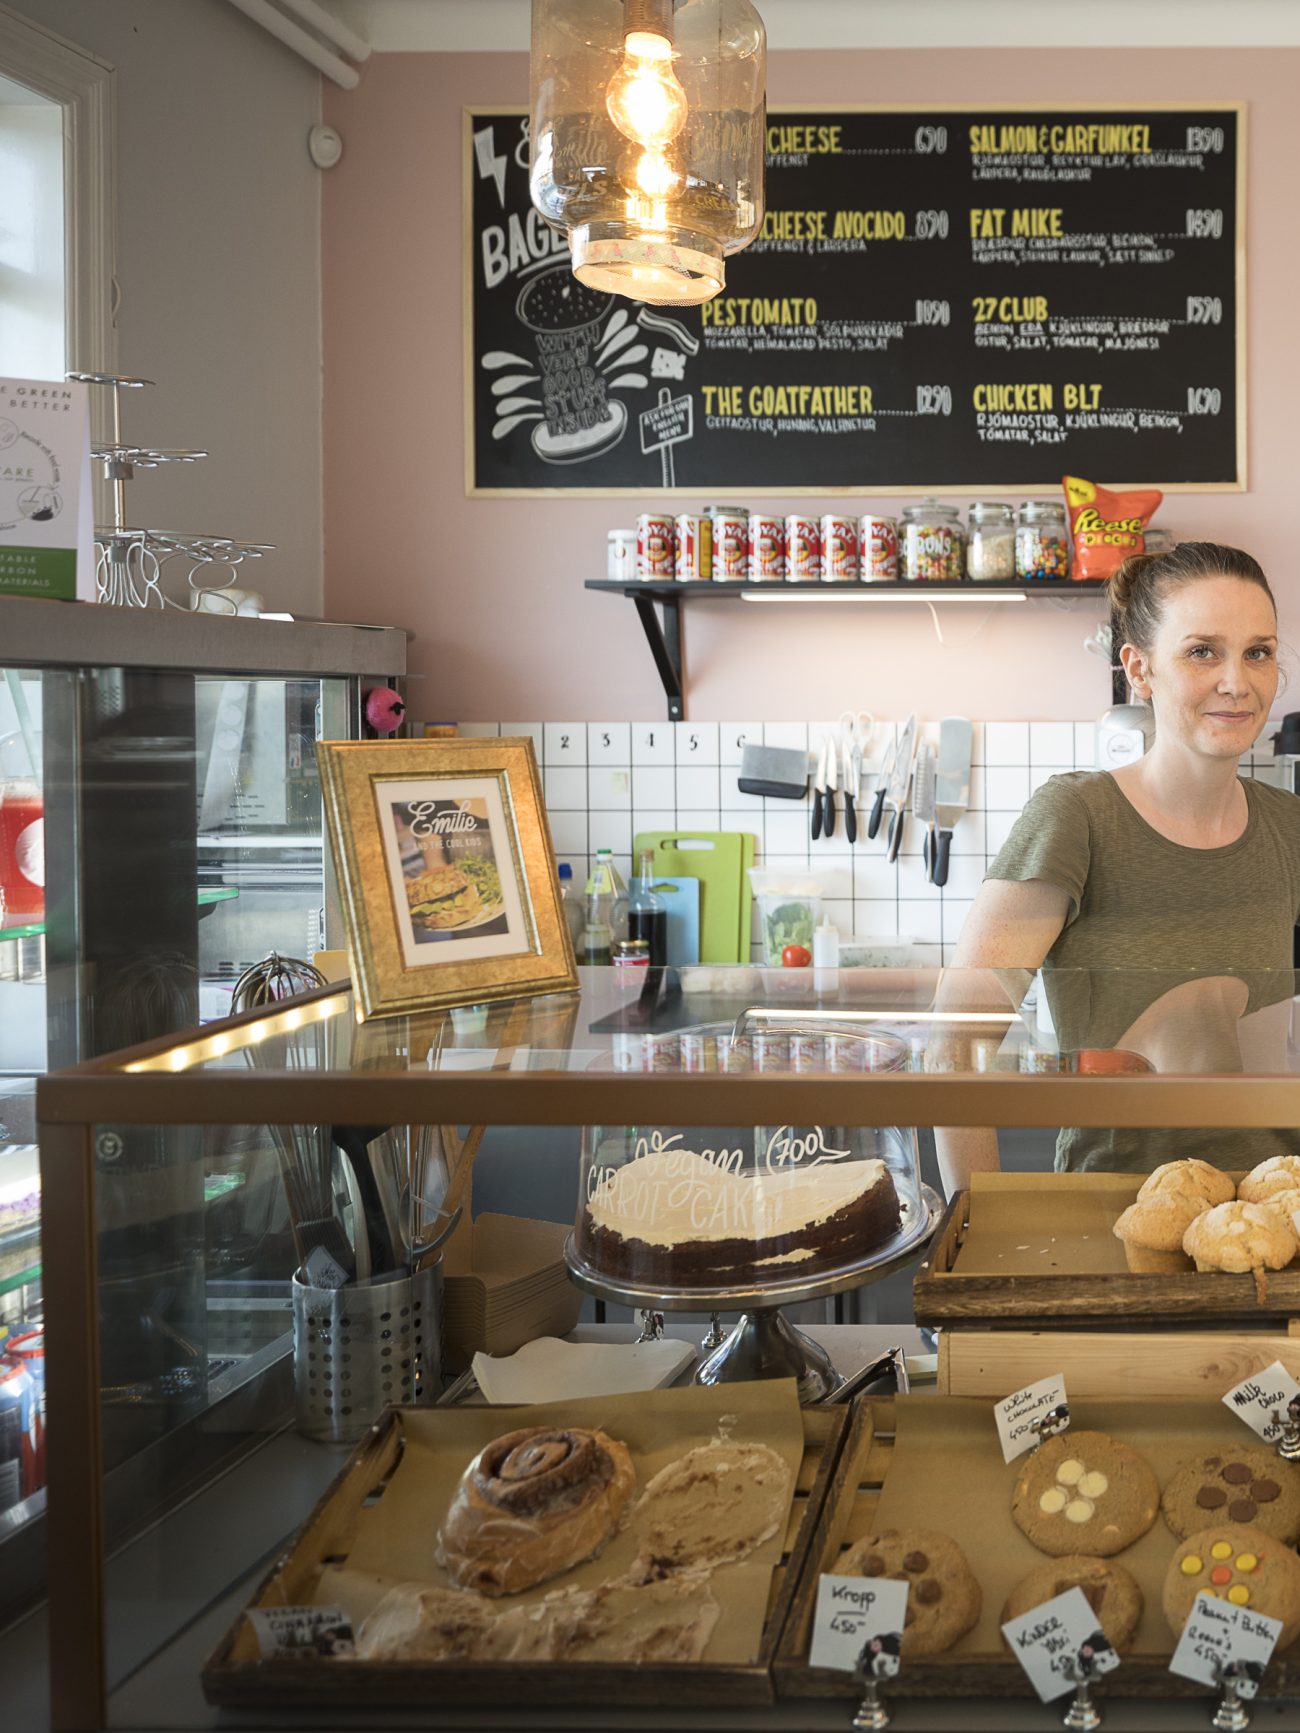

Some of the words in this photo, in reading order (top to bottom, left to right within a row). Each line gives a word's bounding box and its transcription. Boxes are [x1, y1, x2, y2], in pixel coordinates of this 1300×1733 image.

[970, 125, 1037, 154] SALMON
[1051, 125, 1152, 154] GARFUNKEL
[833, 211, 905, 240] AVOCADO
[970, 209, 1005, 238] FAT
[1011, 209, 1063, 238] MIKE
[702, 298, 817, 326] PESTOMATO
[972, 297, 997, 322] 27
[1000, 296, 1048, 322] CLUB
[9, 400, 71, 412] BETTER
[17, 387, 72, 399] GREEN
[702, 386, 743, 415] THE
[749, 386, 873, 416] GOATFATHER
[973, 384, 1053, 412] CHICKEN
[1064, 384, 1103, 411] BLT
[560, 735, 571, 750] 2
[689, 734, 699, 751] 5
[408, 800, 477, 838] Emilie
[587, 1164, 667, 1224] CARROT
[831, 1584, 877, 1612] Kropp
